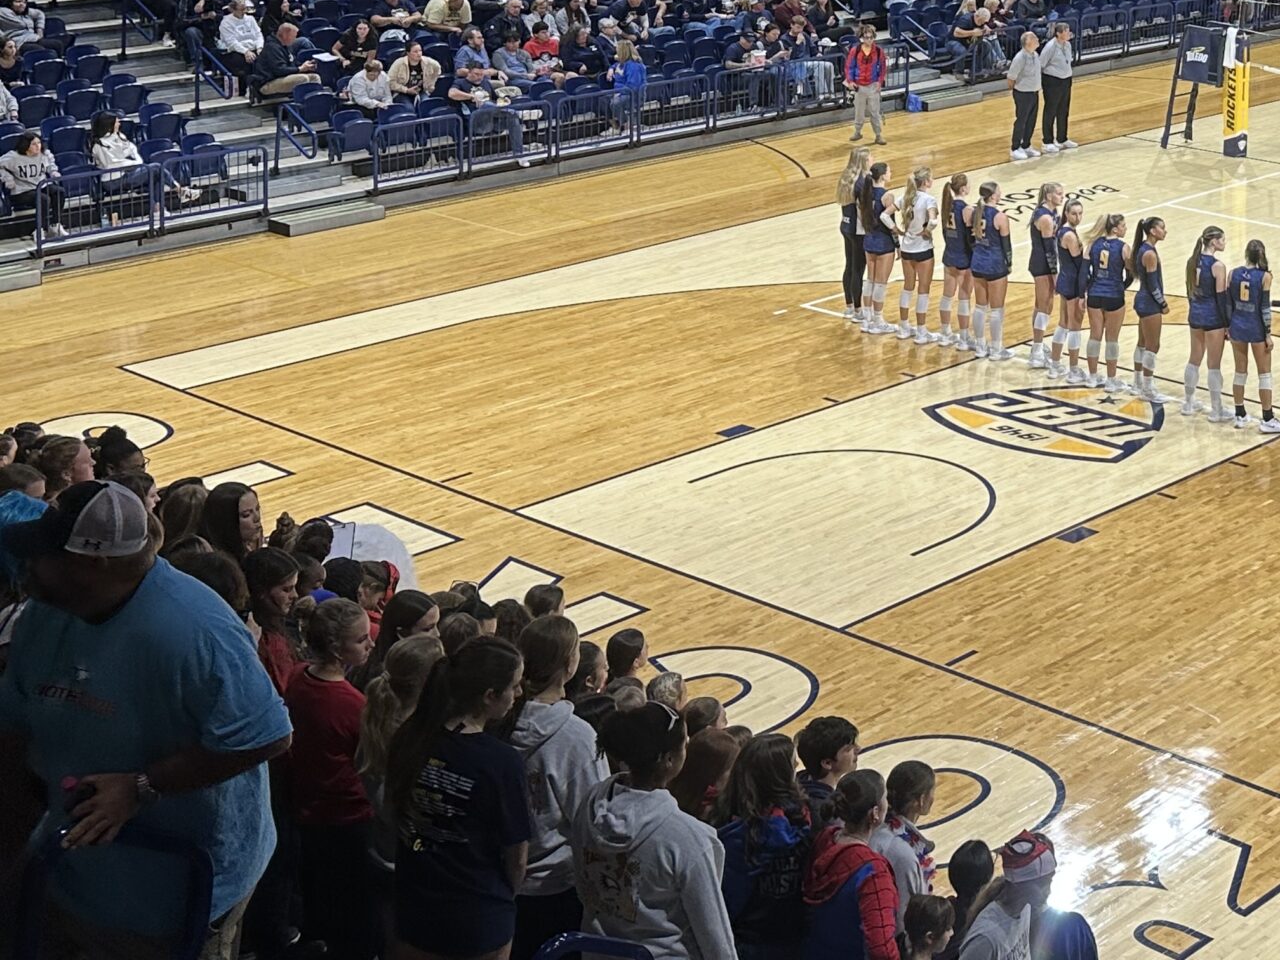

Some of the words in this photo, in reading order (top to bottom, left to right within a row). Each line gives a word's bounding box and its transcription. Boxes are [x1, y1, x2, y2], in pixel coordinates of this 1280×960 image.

[1186, 51, 1208, 63] TOLEDO
[1226, 68, 1237, 131] ROCKETS
[18, 163, 47, 178] NDA
[1099, 249, 1109, 269] 9
[1240, 281, 1250, 301] 6
[989, 425, 1049, 442] 1946
